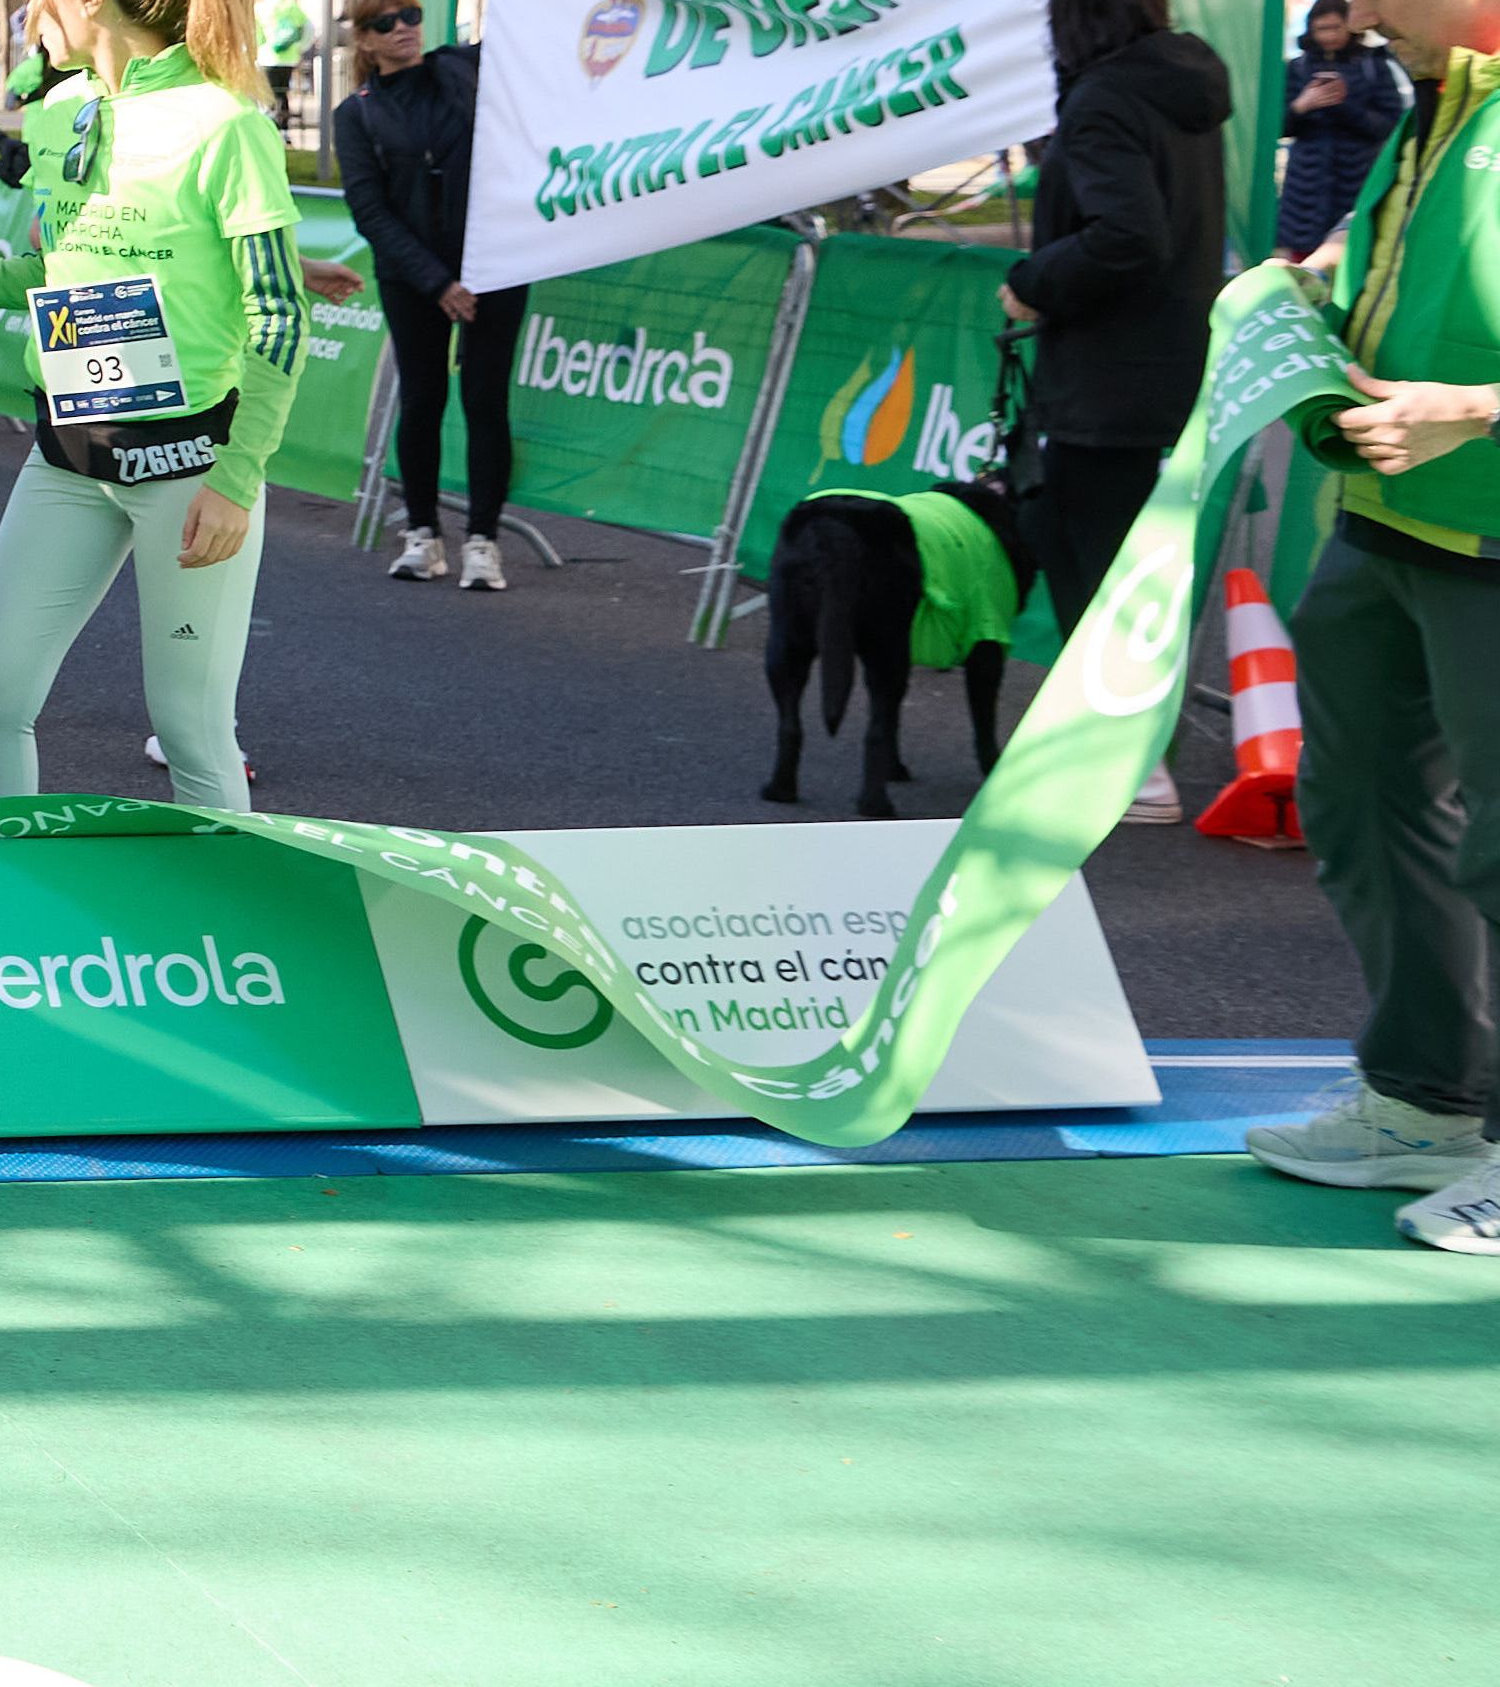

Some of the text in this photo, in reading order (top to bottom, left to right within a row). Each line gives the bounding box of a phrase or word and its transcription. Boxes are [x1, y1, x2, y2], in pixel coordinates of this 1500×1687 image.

[533, 23, 970, 223] CONTRA EL CÁNCER
[56, 200, 146, 223] MADRID EN
[56, 220, 124, 240] MARCHA
[118, 246, 174, 260] CÁNCER
[47, 305, 79, 349] XII
[75, 314, 102, 325] Madrid
[77, 317, 159, 336] contra cáncer
[308, 333, 346, 361] ncer
[86, 356, 123, 384] 93
[111, 434, 218, 484] 226ERS
[621, 905, 832, 941] asociación
[636, 946, 889, 987] contra el cán
[712, 996, 850, 1032] Madrid
